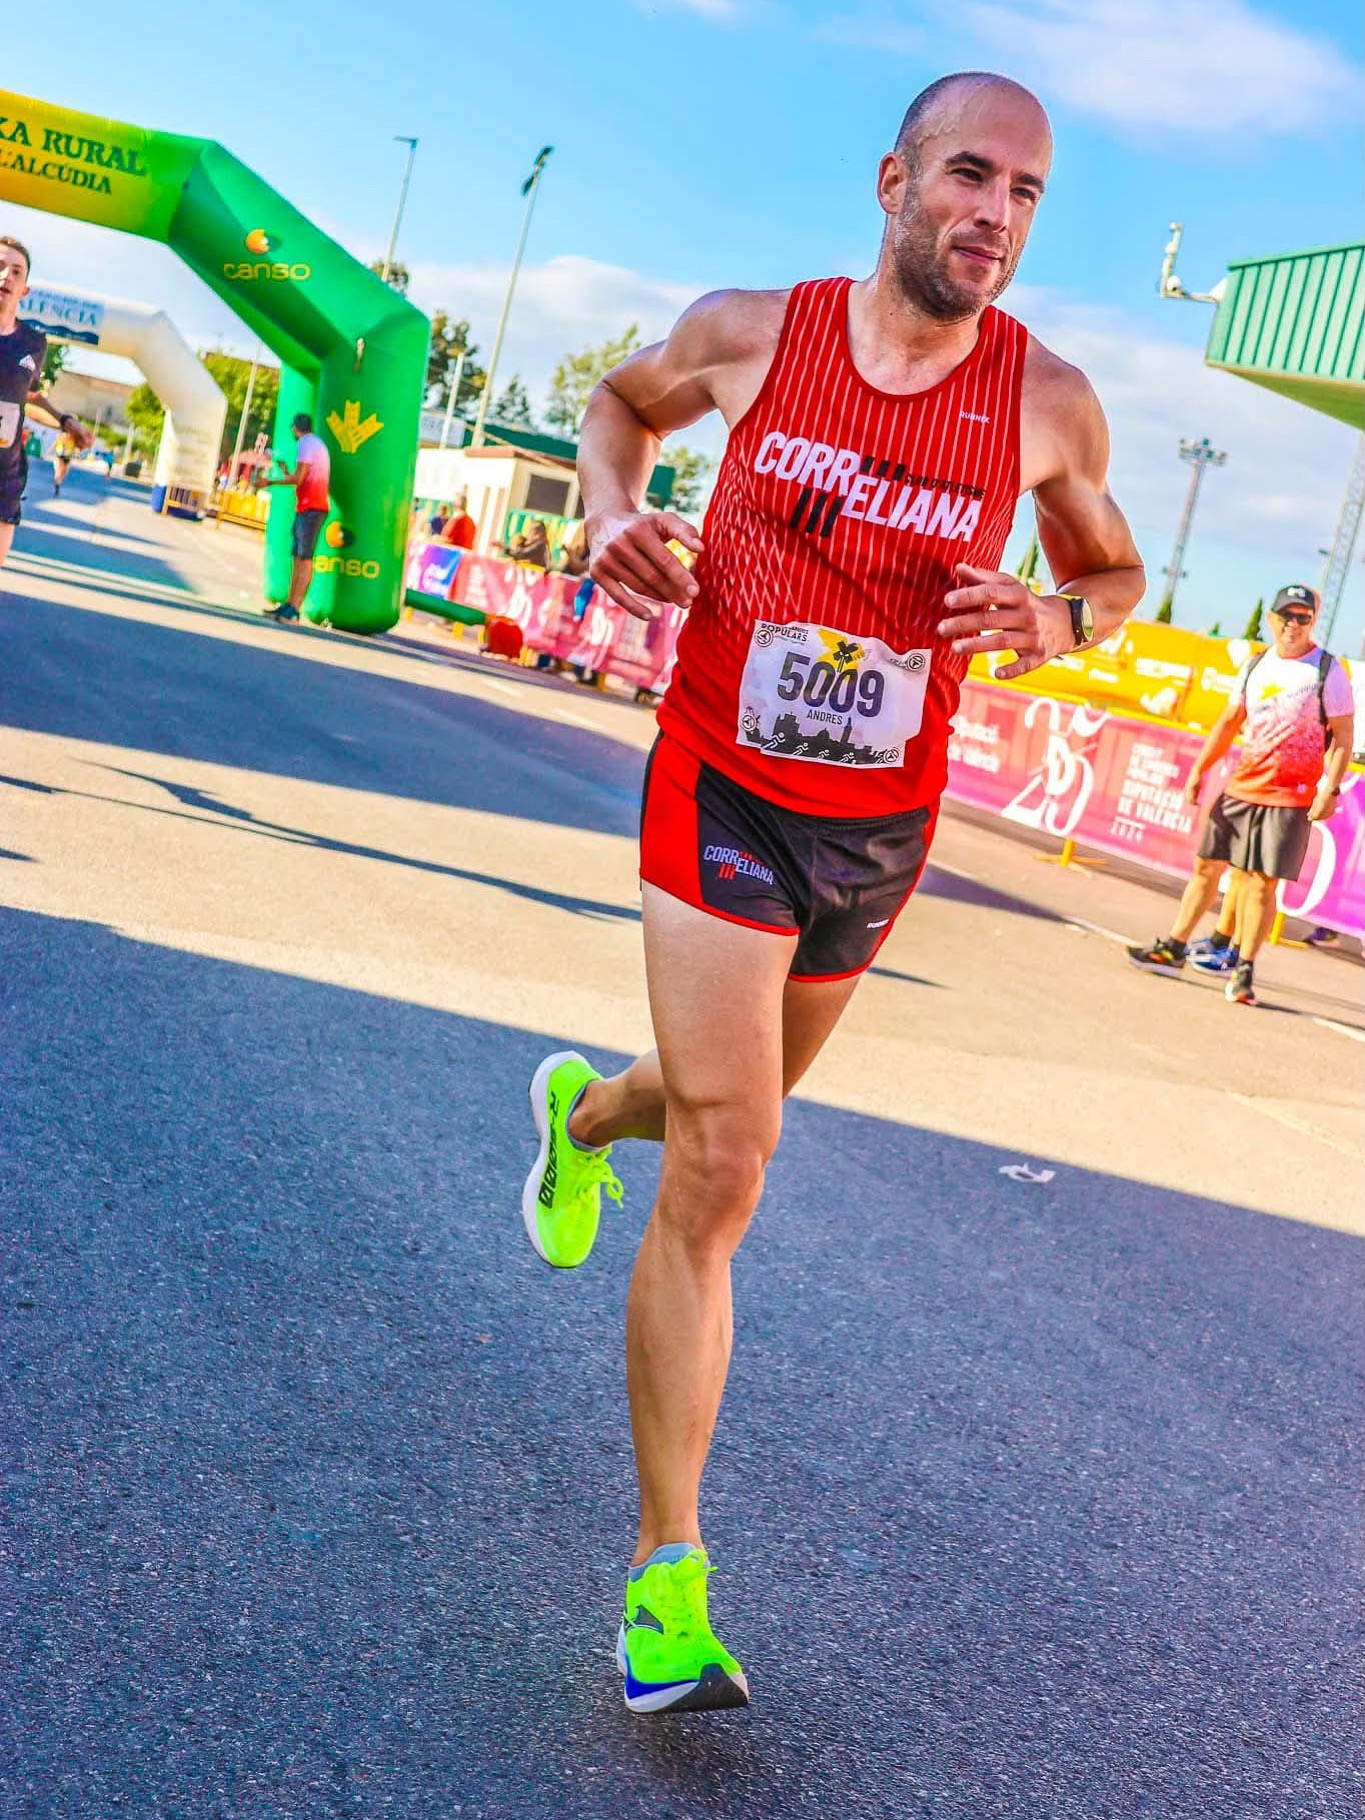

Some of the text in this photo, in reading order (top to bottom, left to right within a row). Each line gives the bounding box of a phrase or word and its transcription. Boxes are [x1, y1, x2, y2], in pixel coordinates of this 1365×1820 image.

[42, 128, 147, 177] RURAL
[223, 262, 312, 281] canso
[761, 622, 807, 642] POPULARS
[777, 650, 886, 718] 5009
[806, 709, 843, 726] ANDRES
